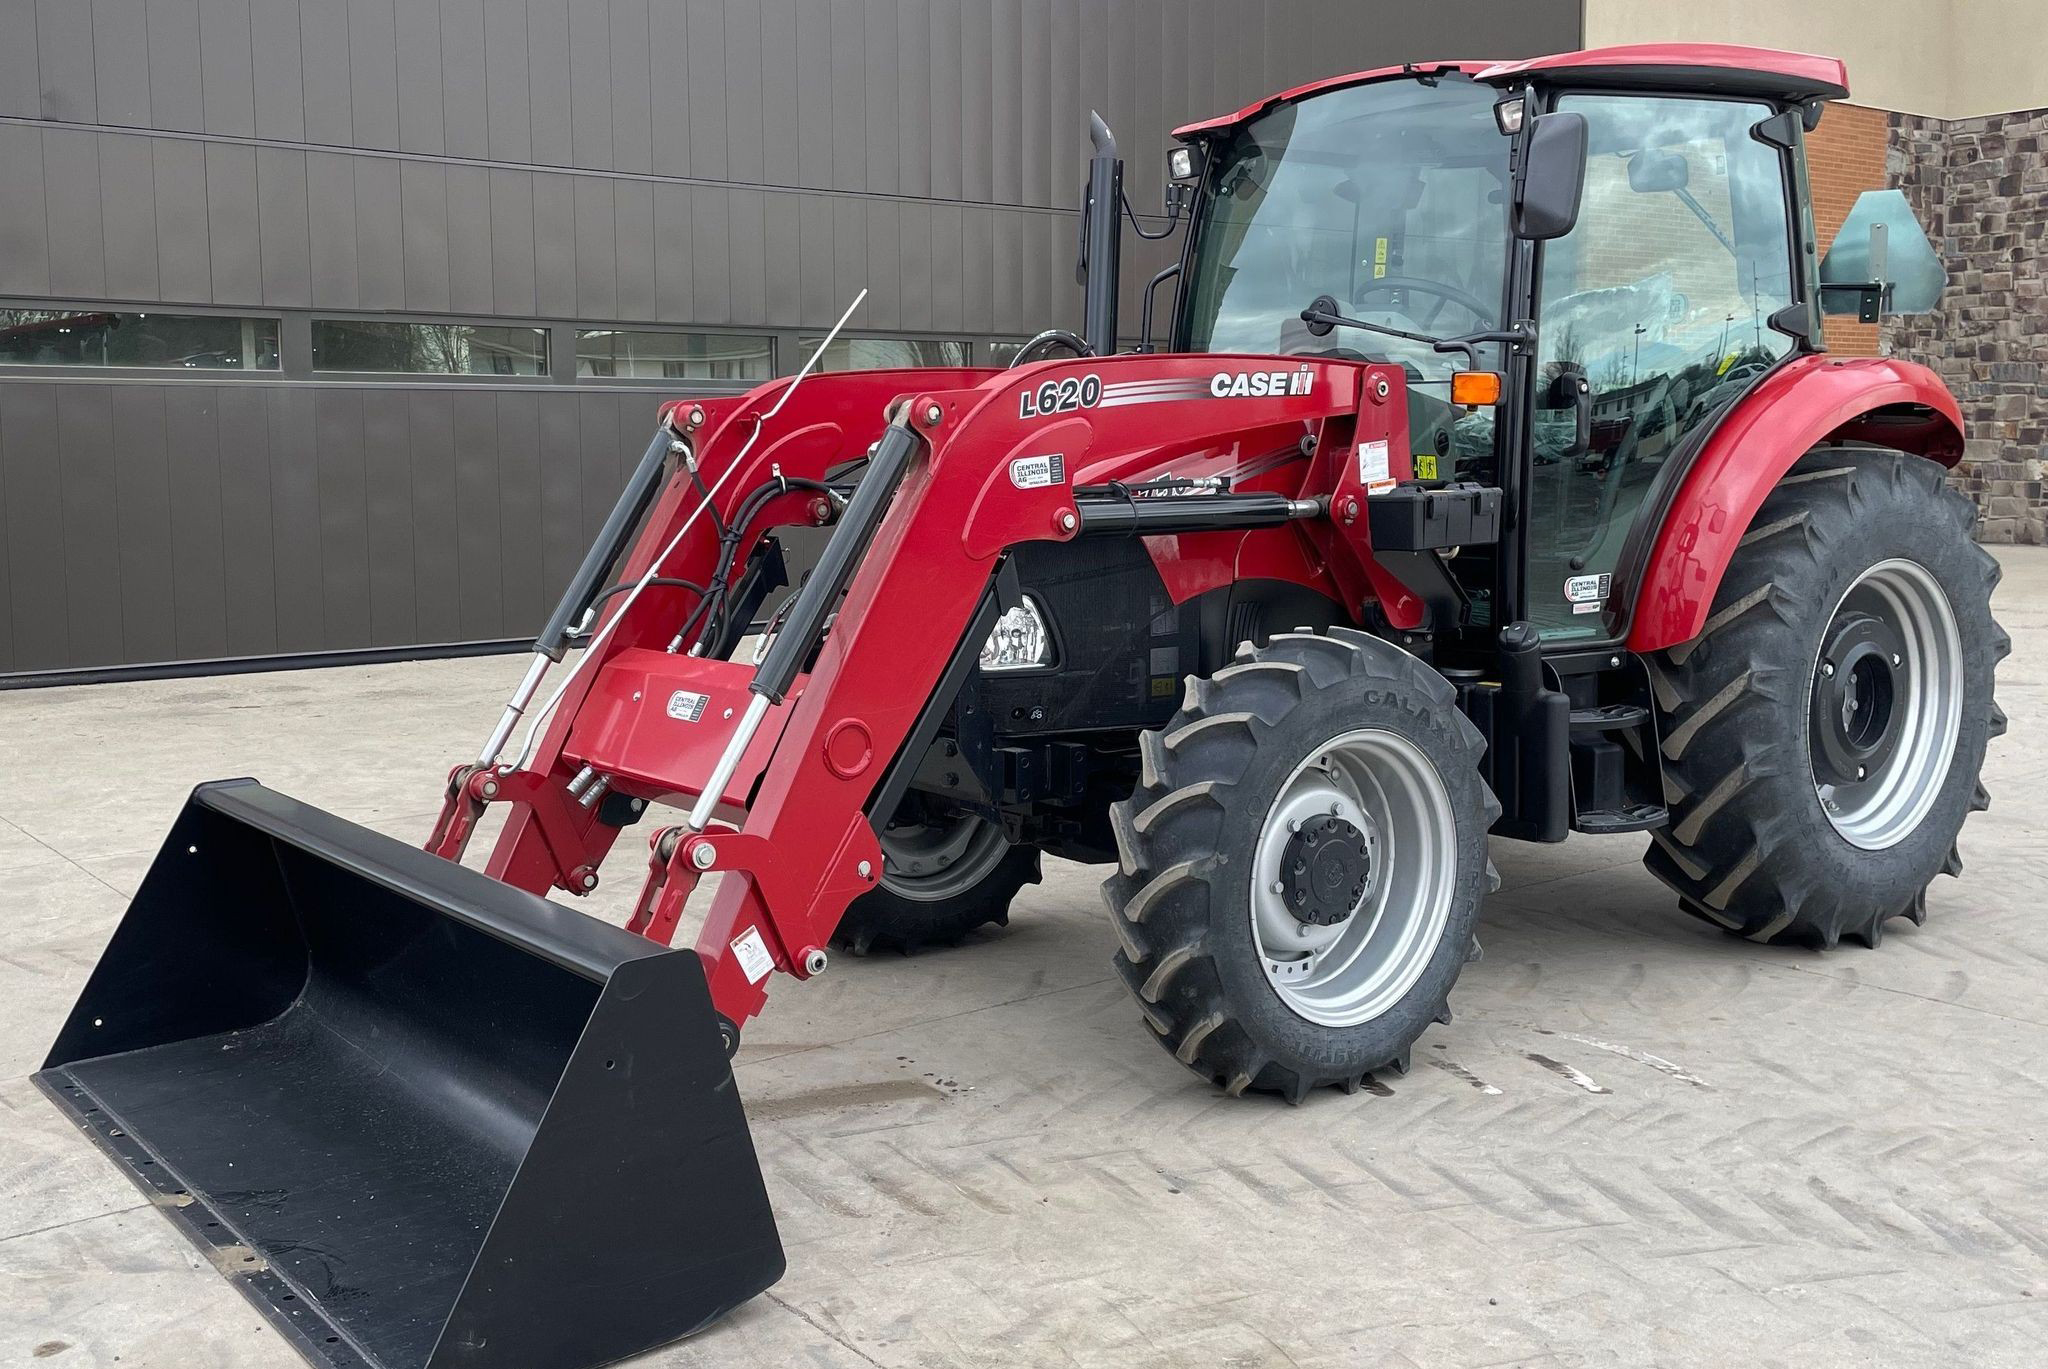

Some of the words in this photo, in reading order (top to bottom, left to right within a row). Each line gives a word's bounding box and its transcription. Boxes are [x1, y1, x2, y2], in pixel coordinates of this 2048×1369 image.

[1210, 372, 1288, 397] CASE
[1019, 374, 1101, 419] L620
[1016, 462, 1048, 471] CENTRAL
[1016, 468, 1049, 477] ILLINOIS
